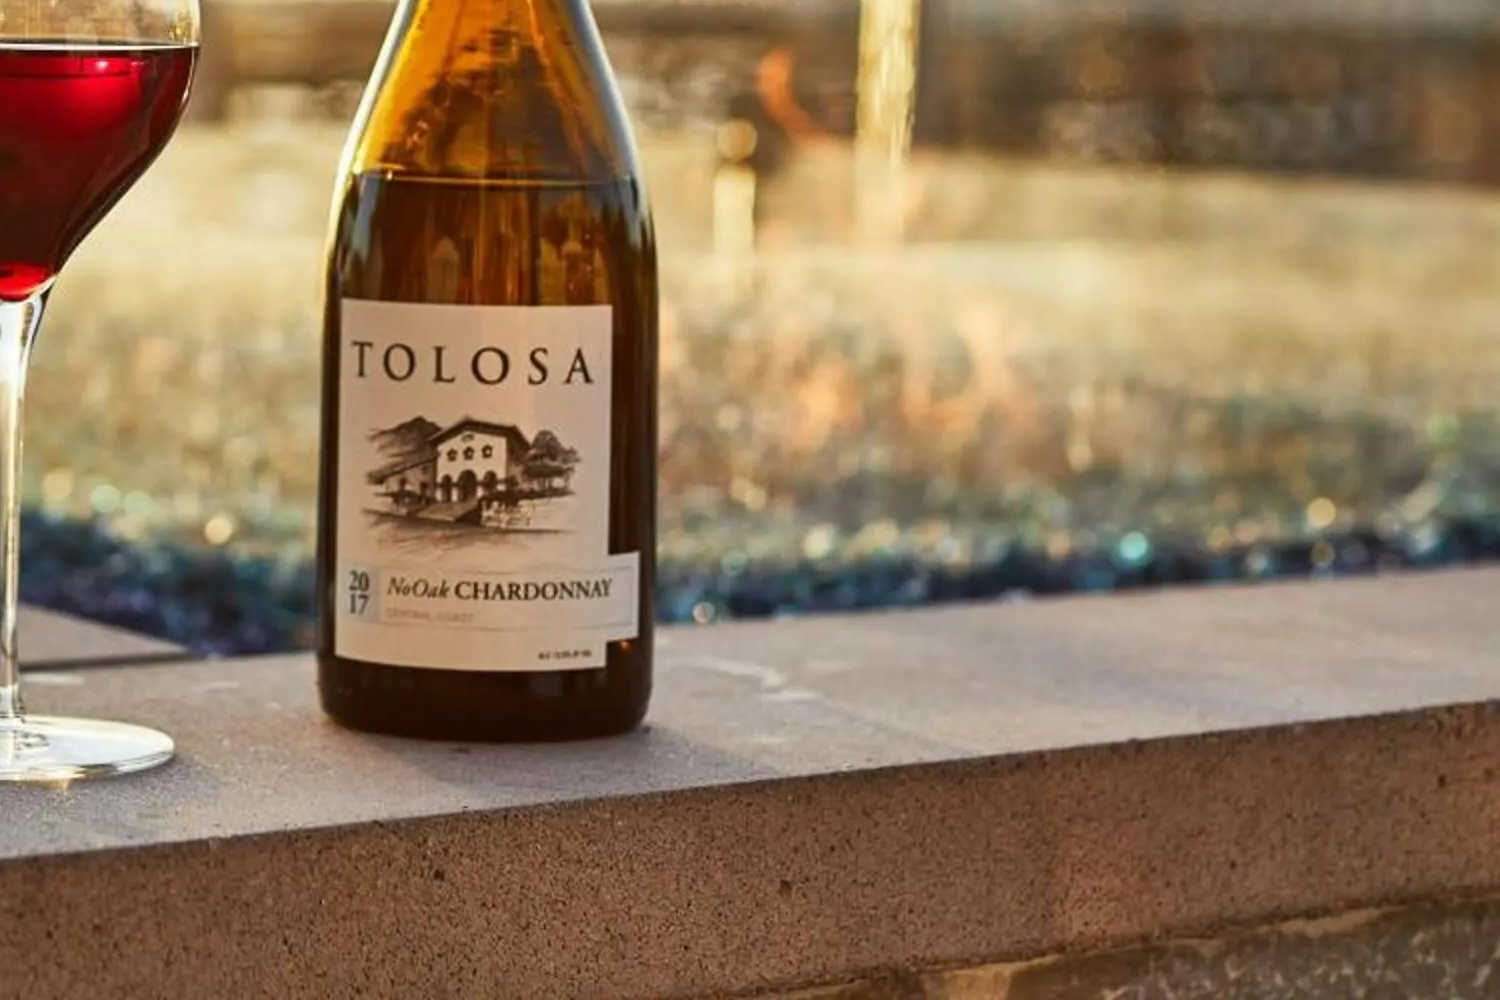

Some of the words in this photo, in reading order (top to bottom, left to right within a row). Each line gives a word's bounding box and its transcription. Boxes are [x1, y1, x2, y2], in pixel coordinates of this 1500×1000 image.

[351, 340, 594, 386] TOLOSA
[348, 569, 370, 592] 20
[454, 577, 613, 602] CHARDONNAY
[349, 593, 371, 615] 17
